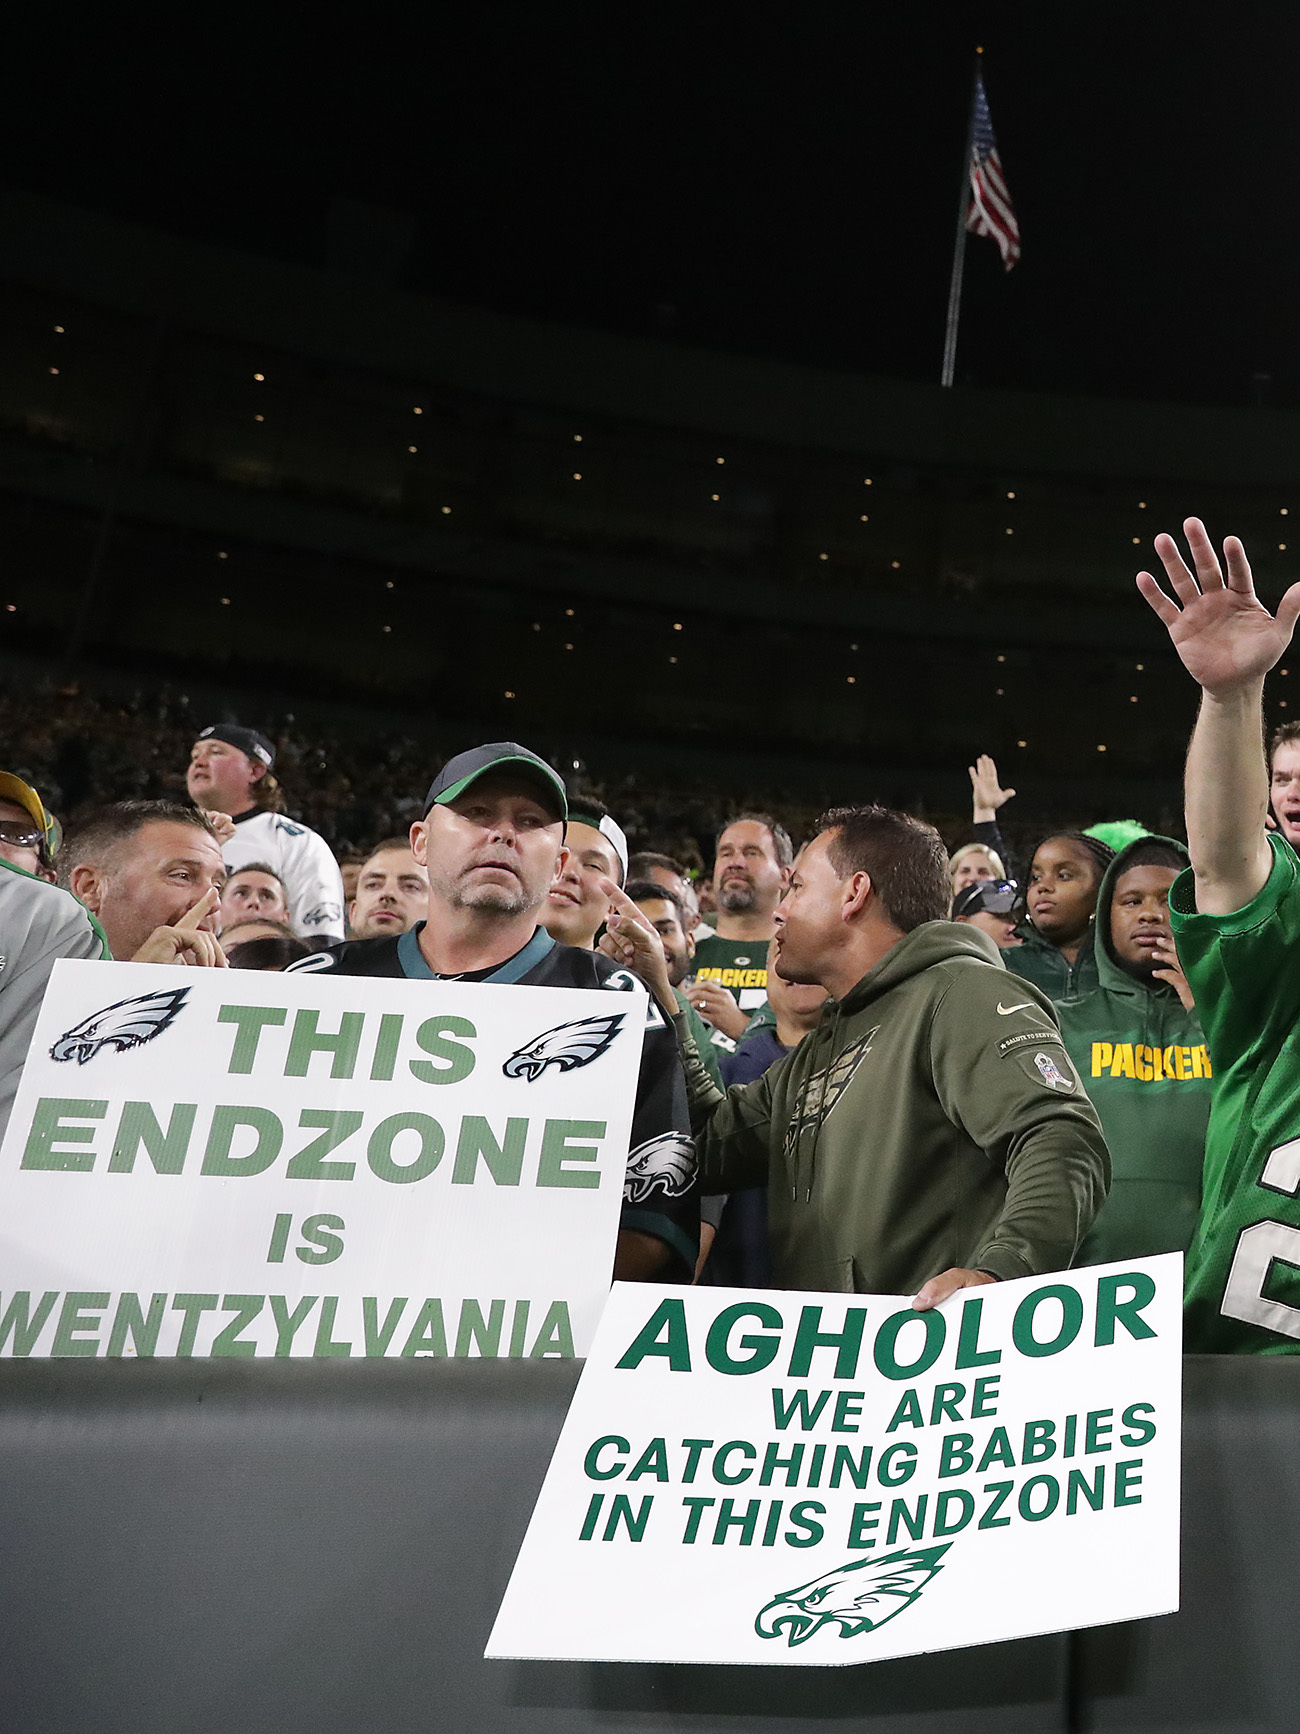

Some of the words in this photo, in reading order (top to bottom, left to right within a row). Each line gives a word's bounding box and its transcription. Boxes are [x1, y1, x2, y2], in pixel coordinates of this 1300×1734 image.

[216, 1004, 478, 1086] THIS
[1090, 1042, 1214, 1082] PACKER
[19, 1098, 608, 1190] ENDZONE
[266, 1213, 346, 1266] IS
[0, 1290, 577, 1358] WENTZYLVANIA
[614, 1271, 1158, 1382] AGHOLOR
[772, 1388, 866, 1433] WE
[885, 1375, 1002, 1433] ARE
[583, 1435, 918, 1489] CATCHING
[937, 1402, 1158, 1479] BABIES
[579, 1493, 655, 1543] IN
[682, 1497, 827, 1549] THIS
[847, 1458, 1144, 1550] ENDZONE
